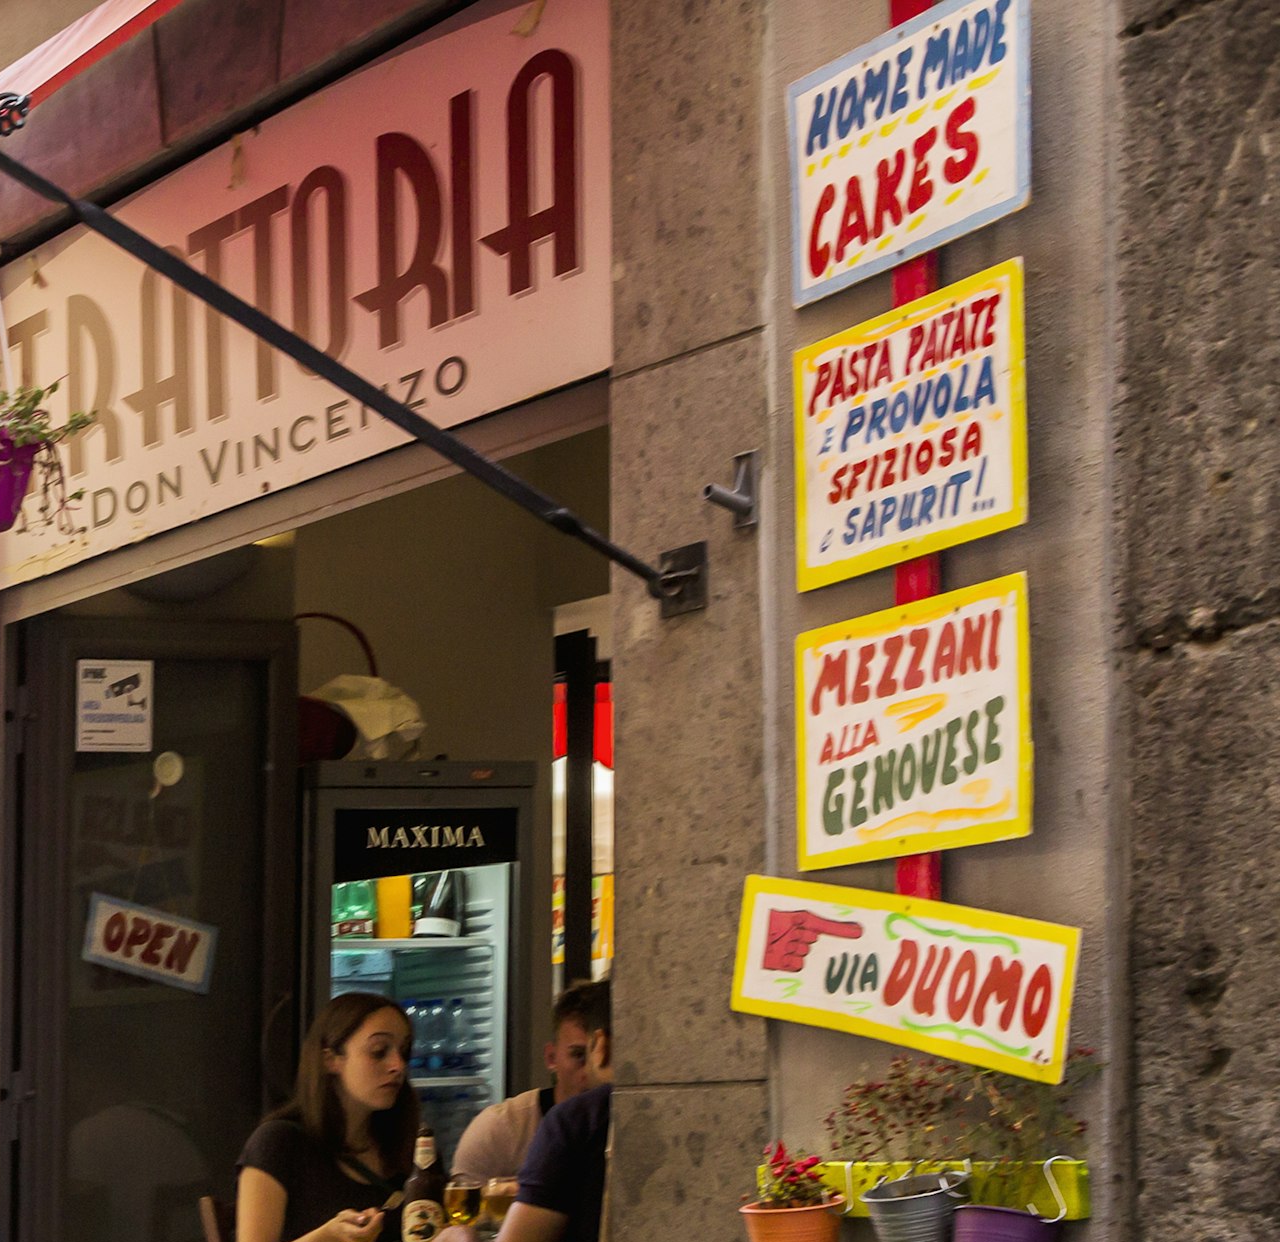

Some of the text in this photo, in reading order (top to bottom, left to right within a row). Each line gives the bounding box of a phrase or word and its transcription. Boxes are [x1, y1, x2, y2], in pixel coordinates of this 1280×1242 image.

[805, 0, 1009, 157] HOME MADE
[808, 96, 979, 279] CAKES
[6, 48, 580, 497] TRATTORIA
[808, 293, 1002, 417] PASTA PATATE
[817, 355, 996, 456] E PROVOLA
[90, 355, 469, 530] DON VINCENZO
[828, 421, 982, 506] SFIZIOSA
[810, 609, 1001, 716] MEZZANI
[818, 720, 880, 766] ALLA
[822, 696, 1006, 837] GENOVESE
[366, 824, 487, 849] MAXIMA
[102, 910, 201, 977] OPEN
[825, 940, 1054, 1039] VIA DUOMO
